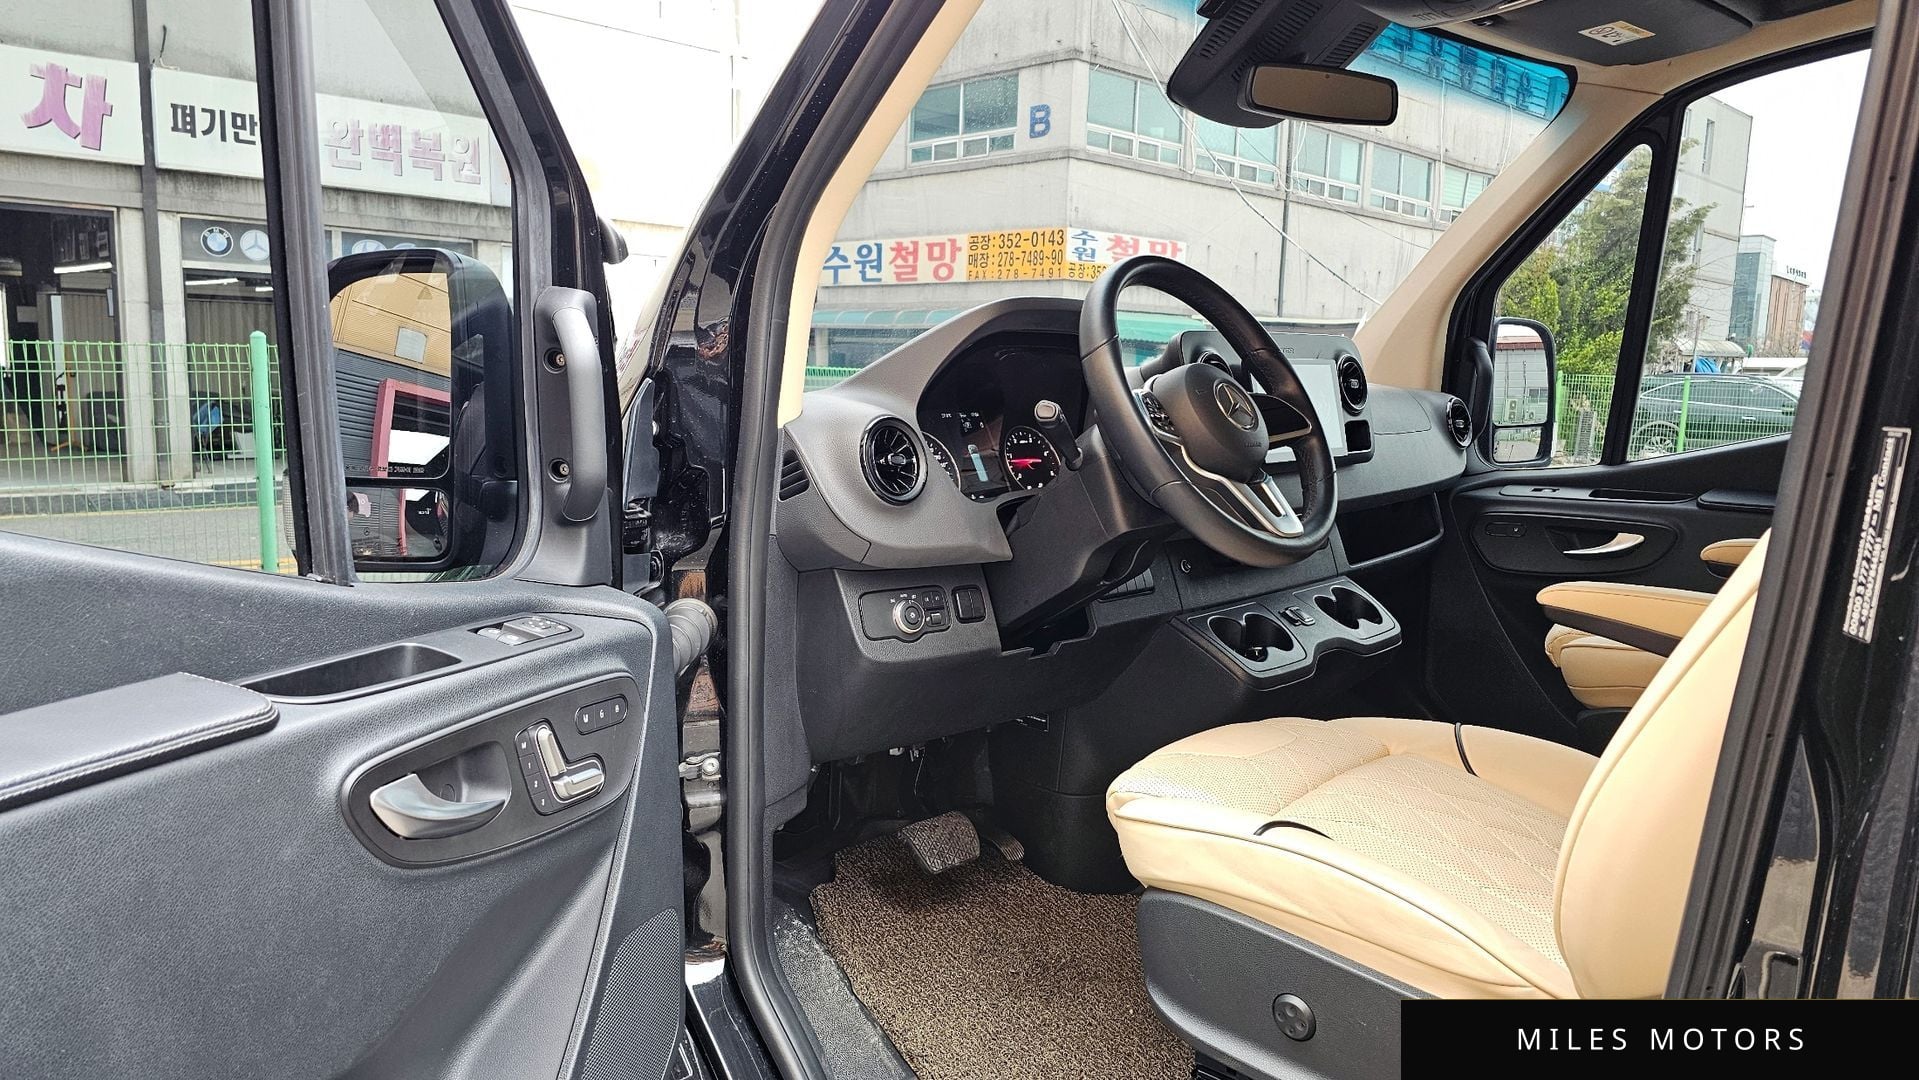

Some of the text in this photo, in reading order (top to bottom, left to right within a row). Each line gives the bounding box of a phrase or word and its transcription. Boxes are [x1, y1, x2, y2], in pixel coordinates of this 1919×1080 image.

[20, 62, 113, 151] 차
[1029, 104, 1051, 139] B
[324, 118, 482, 185] 완벽복원
